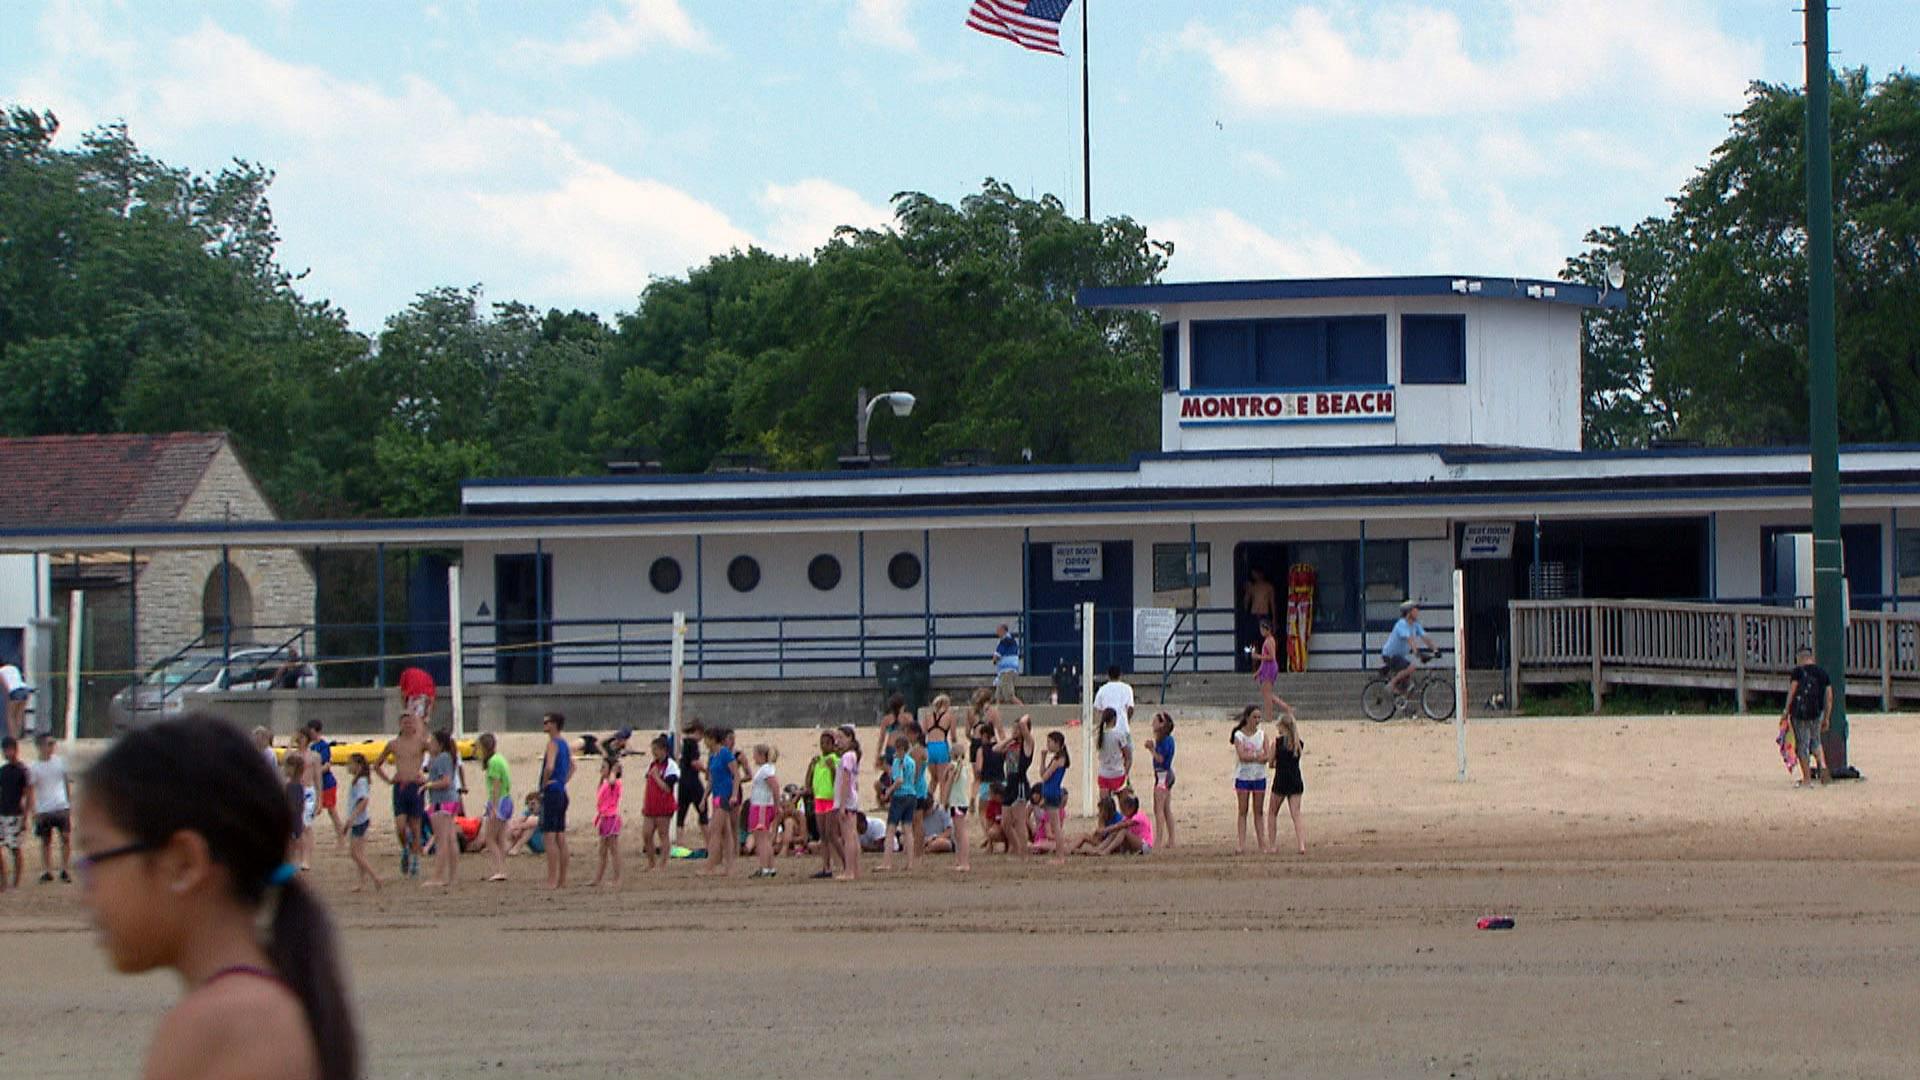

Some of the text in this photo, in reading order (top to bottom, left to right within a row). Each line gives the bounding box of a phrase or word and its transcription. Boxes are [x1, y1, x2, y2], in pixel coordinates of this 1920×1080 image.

[1181, 393, 1393, 417] MONTROE BEACH
[1474, 535, 1500, 545] OPEN
